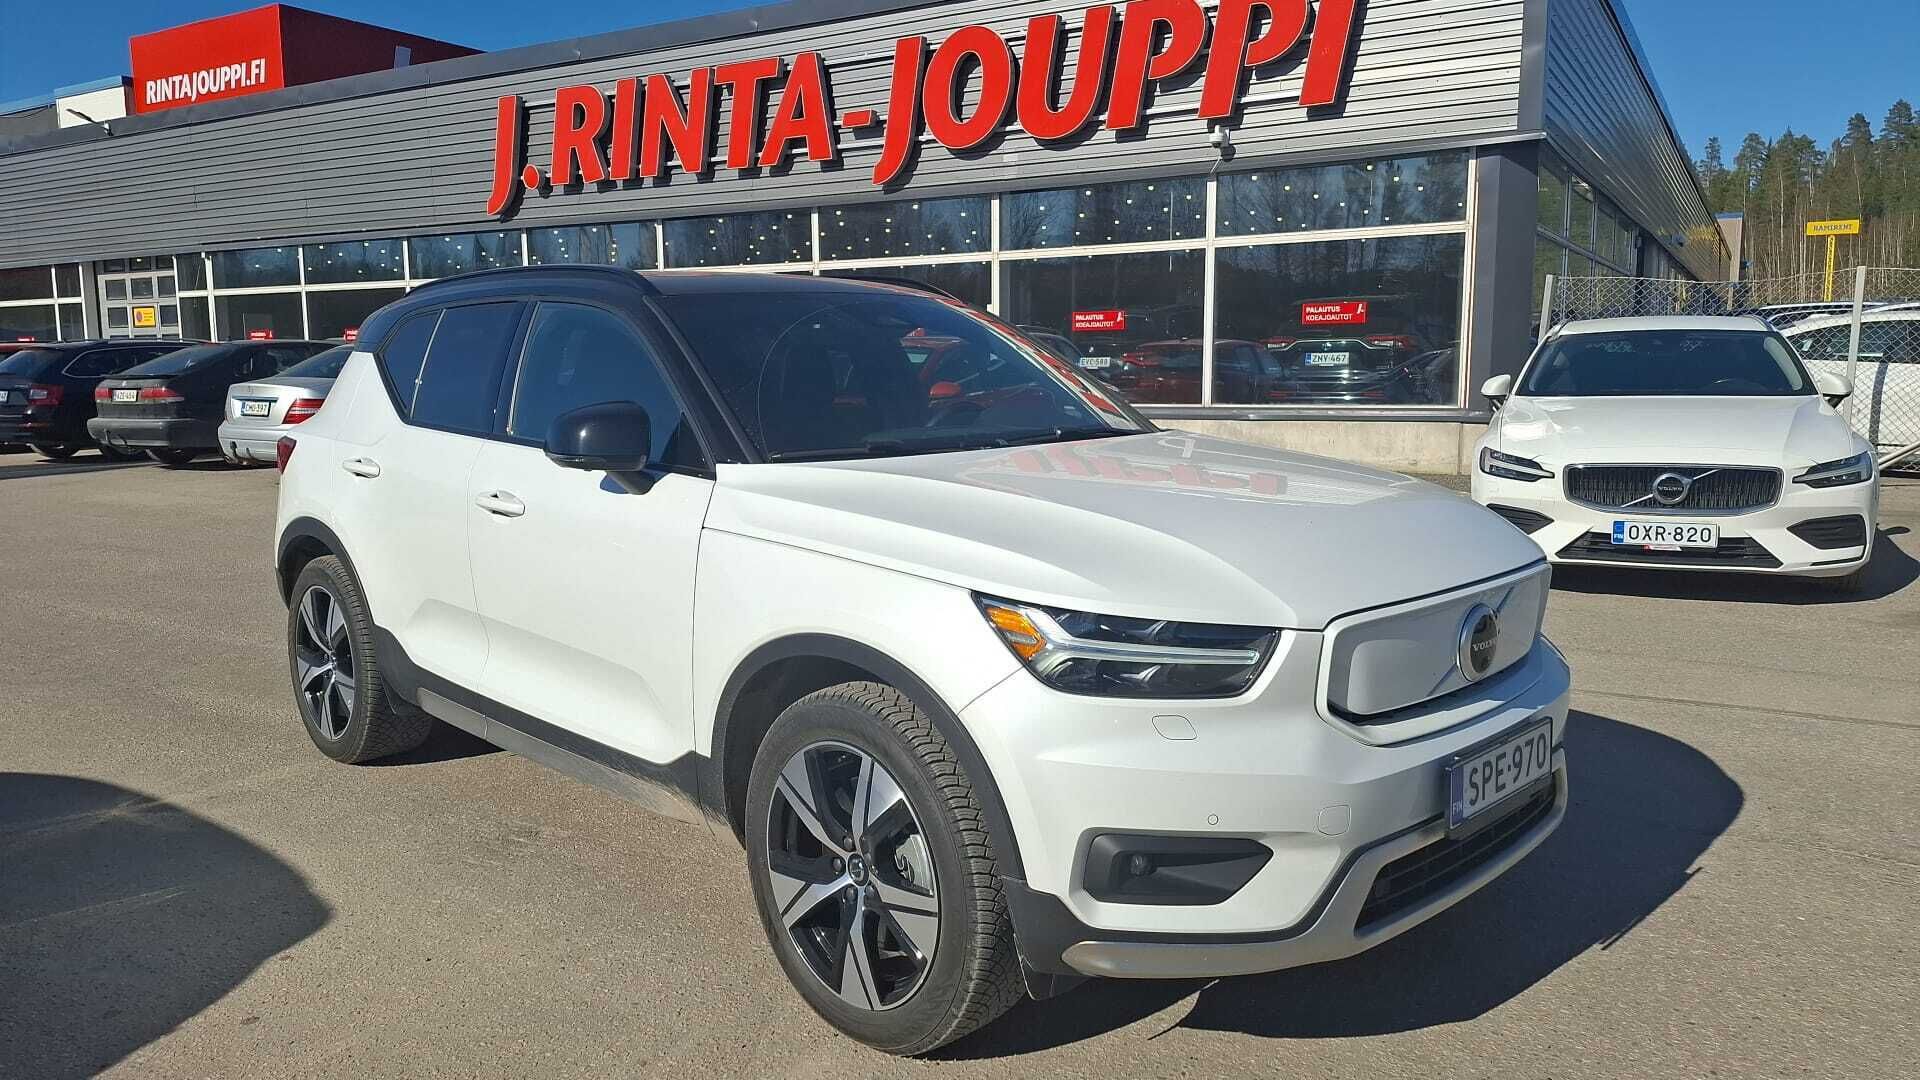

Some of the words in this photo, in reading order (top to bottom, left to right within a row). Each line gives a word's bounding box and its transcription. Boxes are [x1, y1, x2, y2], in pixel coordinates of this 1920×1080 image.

[145, 57, 266, 105] RINTAJOUPPI.FI
[1305, 305, 1341, 313] PALAUTUS
[1075, 313, 1105, 321] PALAUTUS
[1305, 313, 1353, 321] KOEAJOAUTOT
[1628, 524, 1712, 543] OXR-820
[1468, 732, 1548, 806] SPE-970
